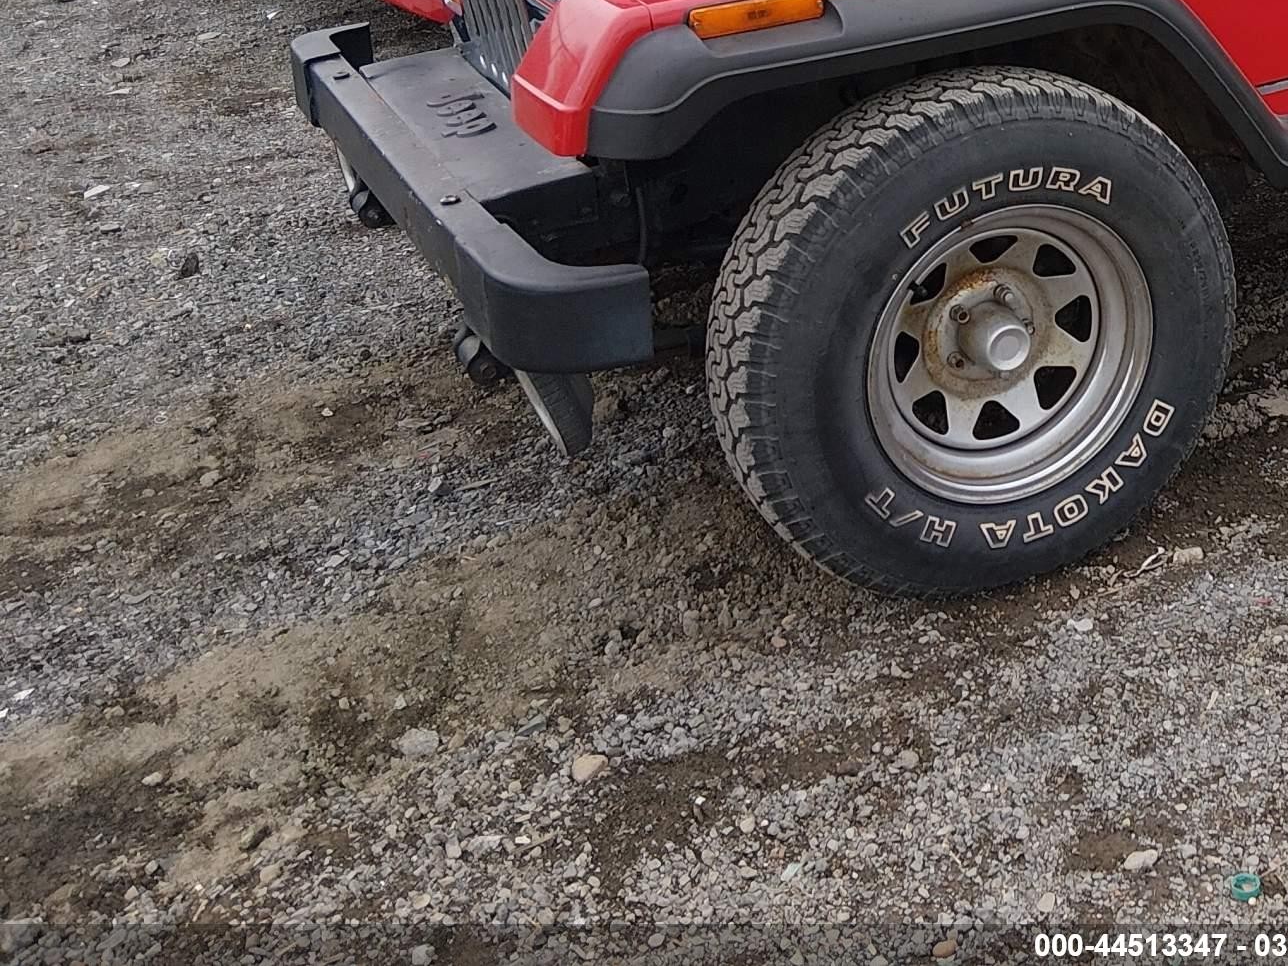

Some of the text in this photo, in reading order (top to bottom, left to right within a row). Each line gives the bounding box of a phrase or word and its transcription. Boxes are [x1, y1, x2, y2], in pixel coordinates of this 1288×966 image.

[426, 93, 497, 138] Jeep
[899, 166, 1113, 249] FUTURA
[864, 398, 1175, 549] DAKOTA H/T
